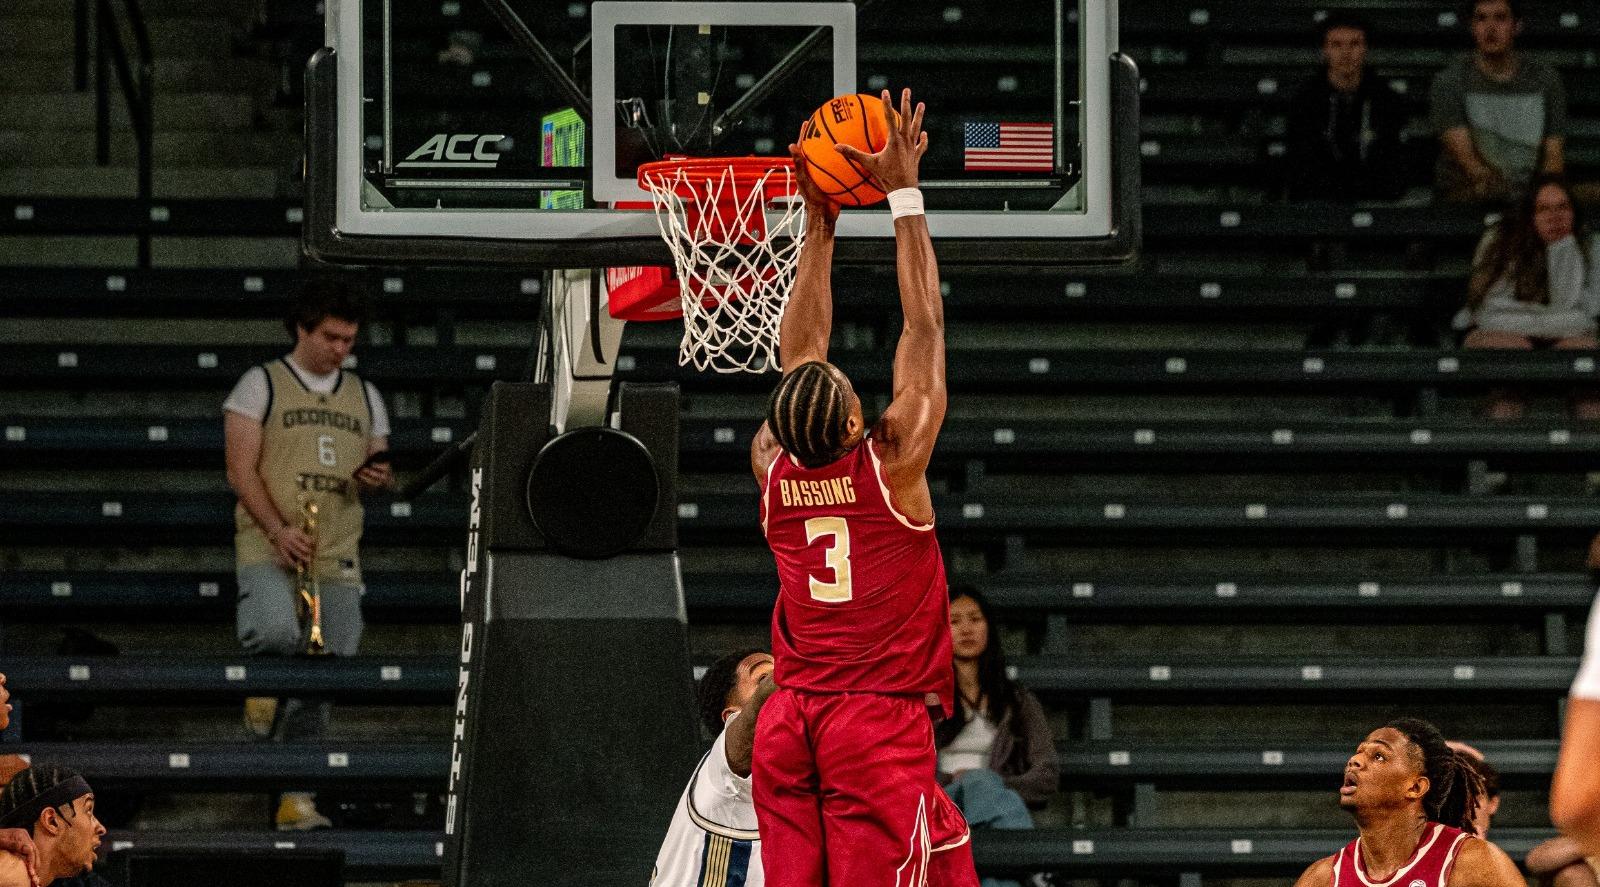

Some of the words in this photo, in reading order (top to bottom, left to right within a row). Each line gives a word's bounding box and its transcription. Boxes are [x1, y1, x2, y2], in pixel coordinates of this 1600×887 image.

[405, 134, 505, 160] ACC
[282, 409, 361, 434] GEORGIA
[318, 435, 337, 466] 6
[780, 476, 857, 507] BASSONG
[804, 516, 853, 603] 3
[445, 622, 473, 835] STING
